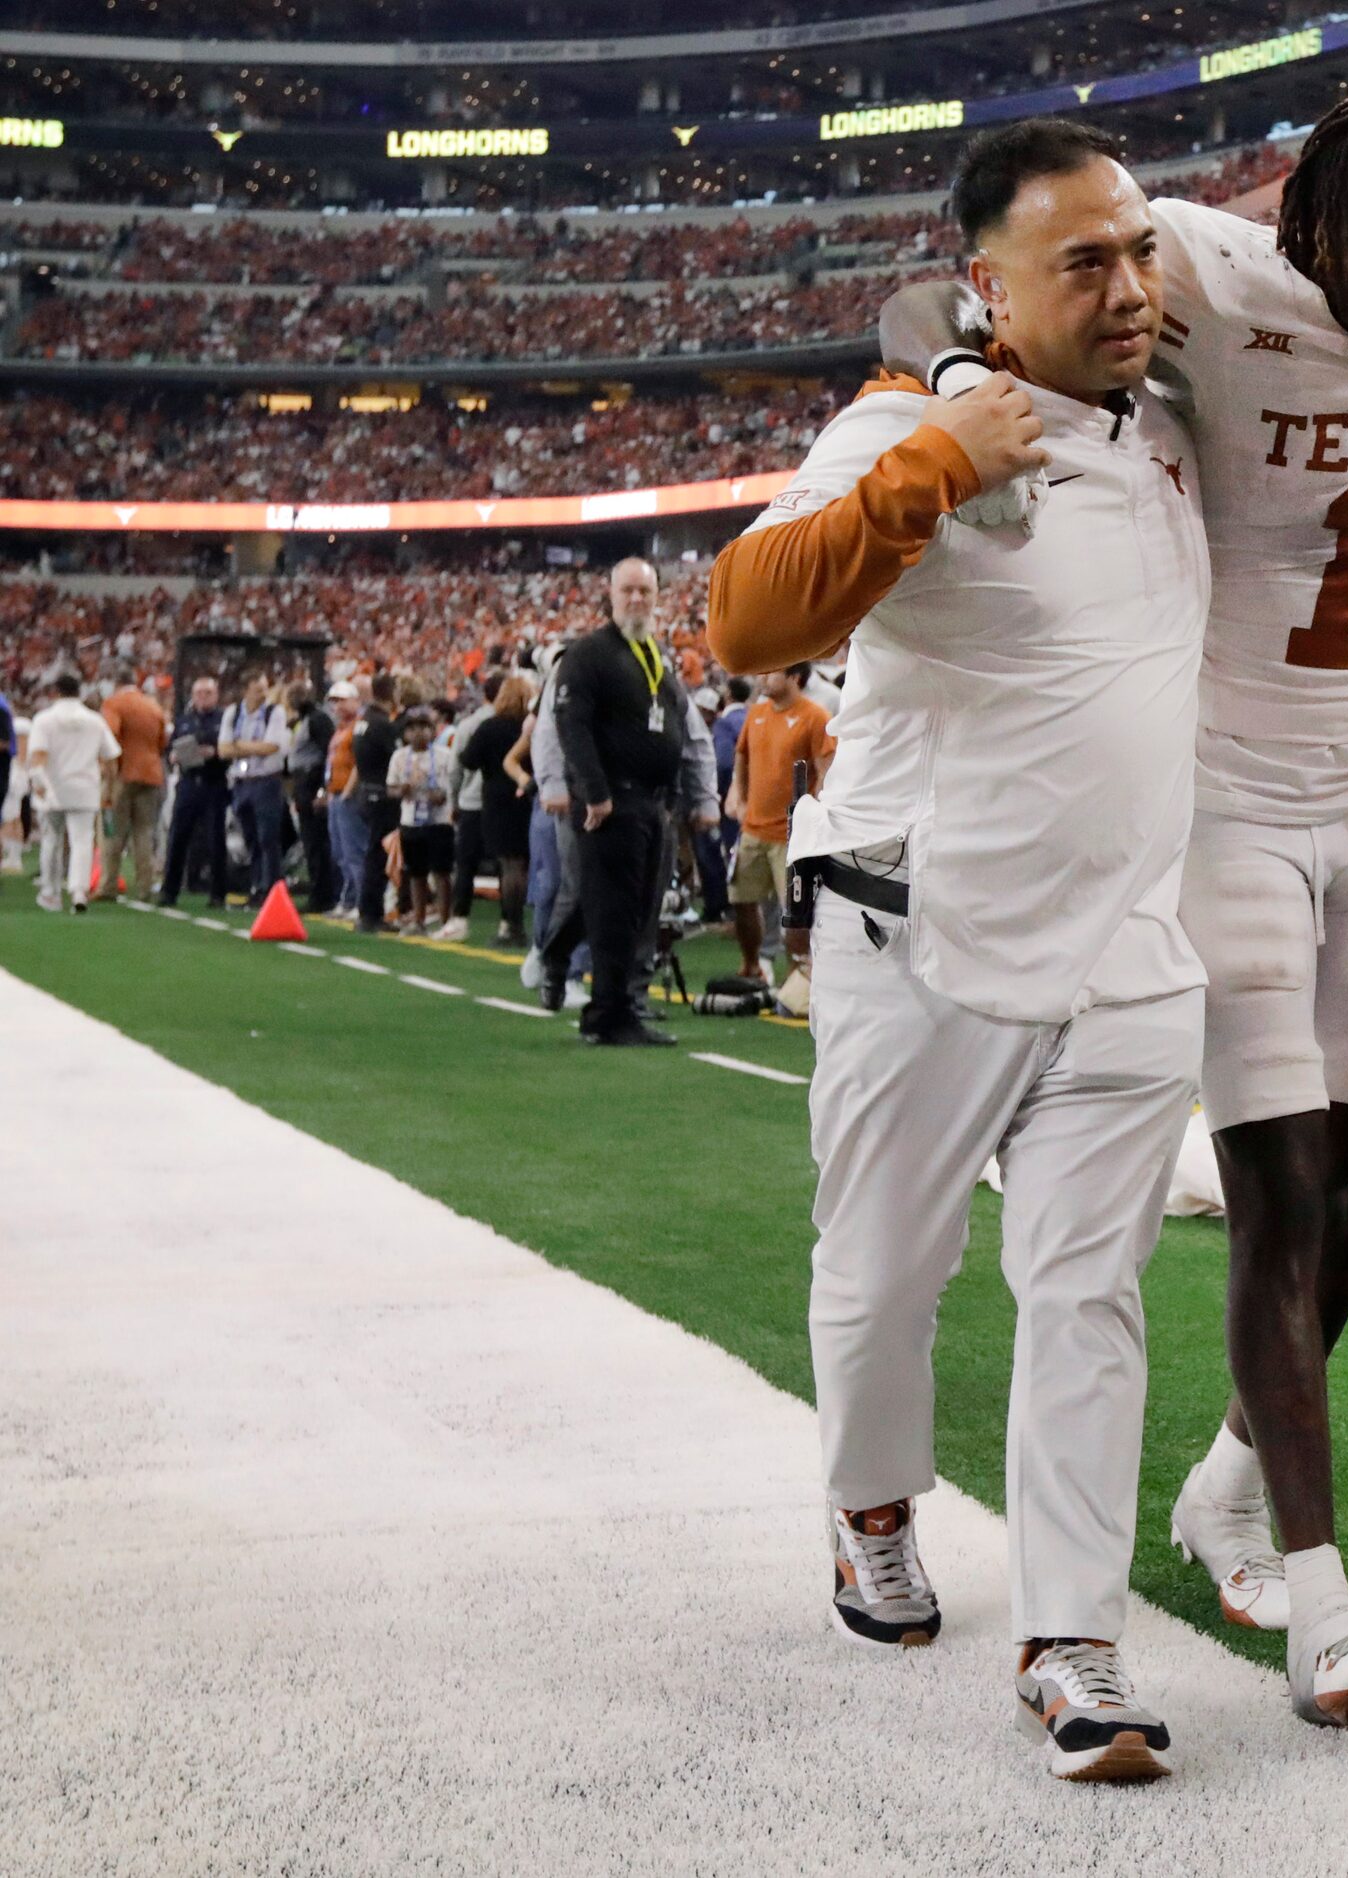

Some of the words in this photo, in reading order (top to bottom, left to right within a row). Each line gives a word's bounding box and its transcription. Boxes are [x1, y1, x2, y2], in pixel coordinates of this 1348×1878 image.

[1200, 28, 1322, 82] LONGHORNS
[0, 118, 64, 148] RNS
[820, 101, 963, 139] LONGHORNS
[387, 129, 549, 157] LONGHORNS
[1244, 327, 1297, 355] XII
